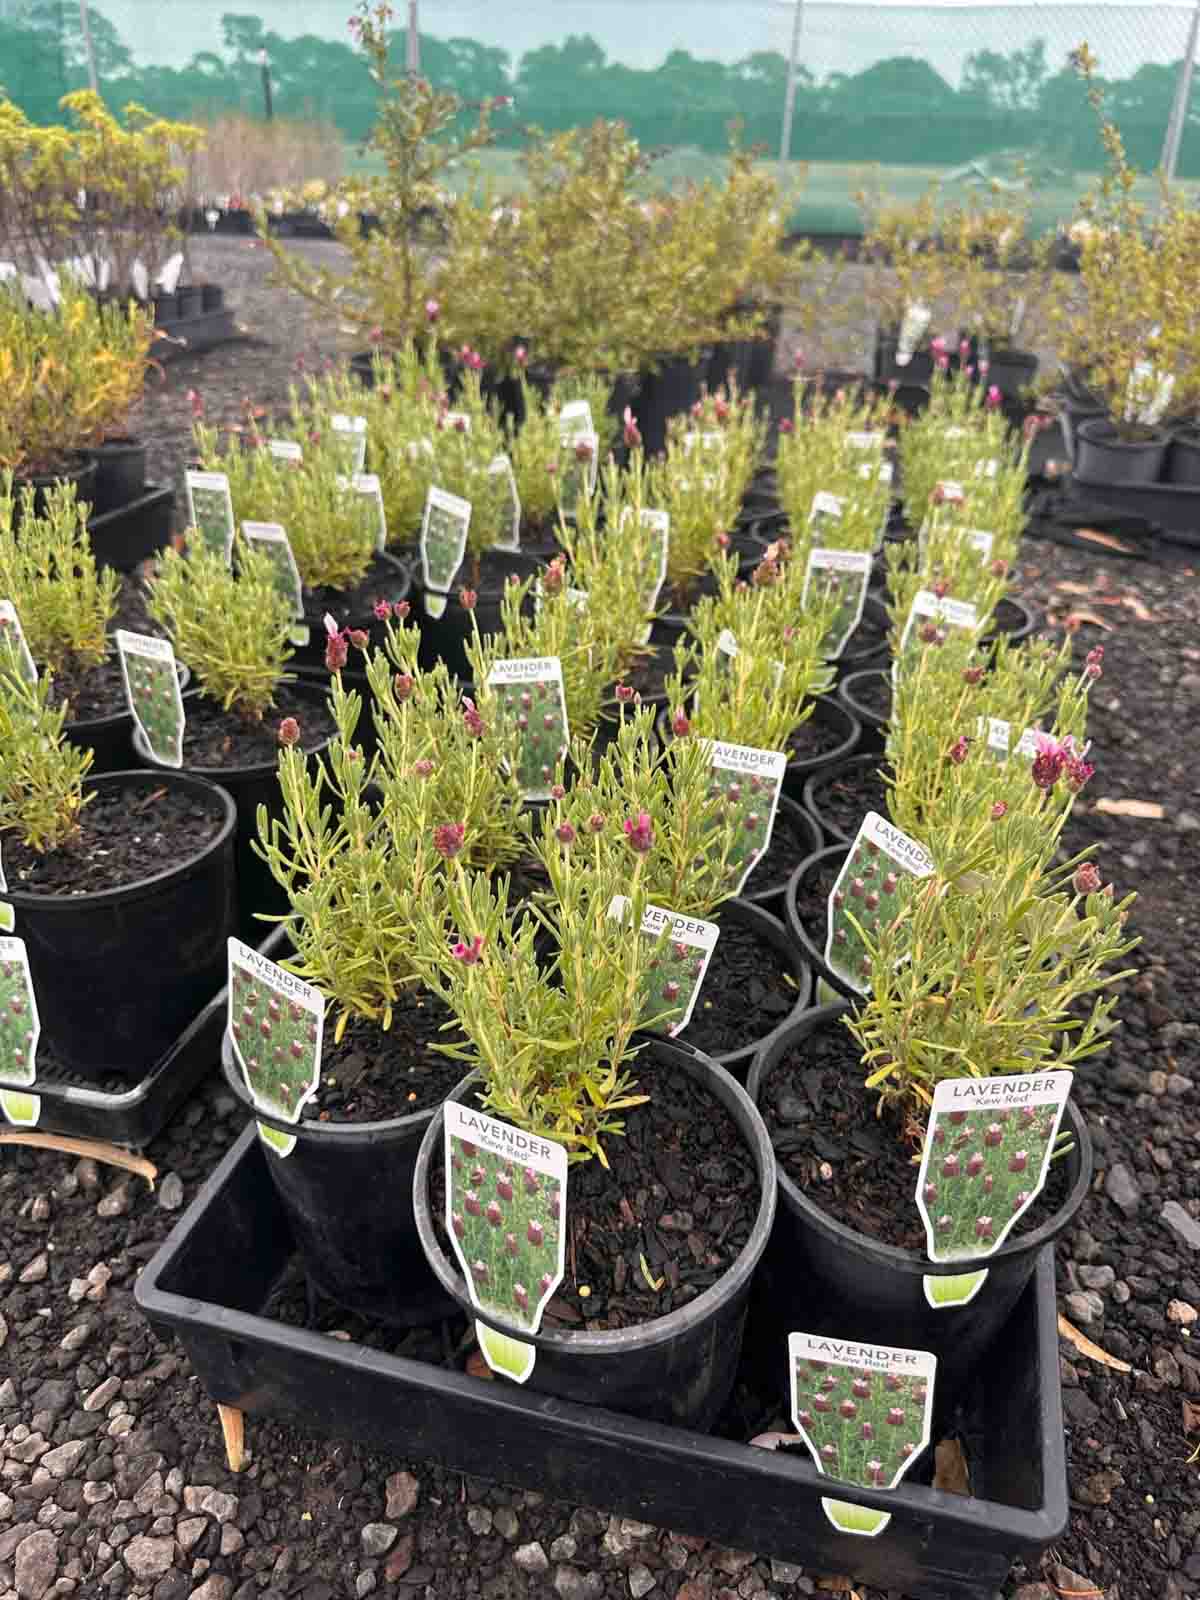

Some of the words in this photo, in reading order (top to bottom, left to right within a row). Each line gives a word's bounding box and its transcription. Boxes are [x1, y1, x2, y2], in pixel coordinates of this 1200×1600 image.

[498, 662, 552, 672] AVENDER
[714, 745, 777, 768] AVENDER
[644, 908, 705, 937] VENDER
[239, 946, 312, 999] LAVENDER
[953, 1079, 1056, 1097] LAVENDER
[459, 1111, 551, 1159] LAVENDER
[807, 1338, 917, 1364] LAVENDER
